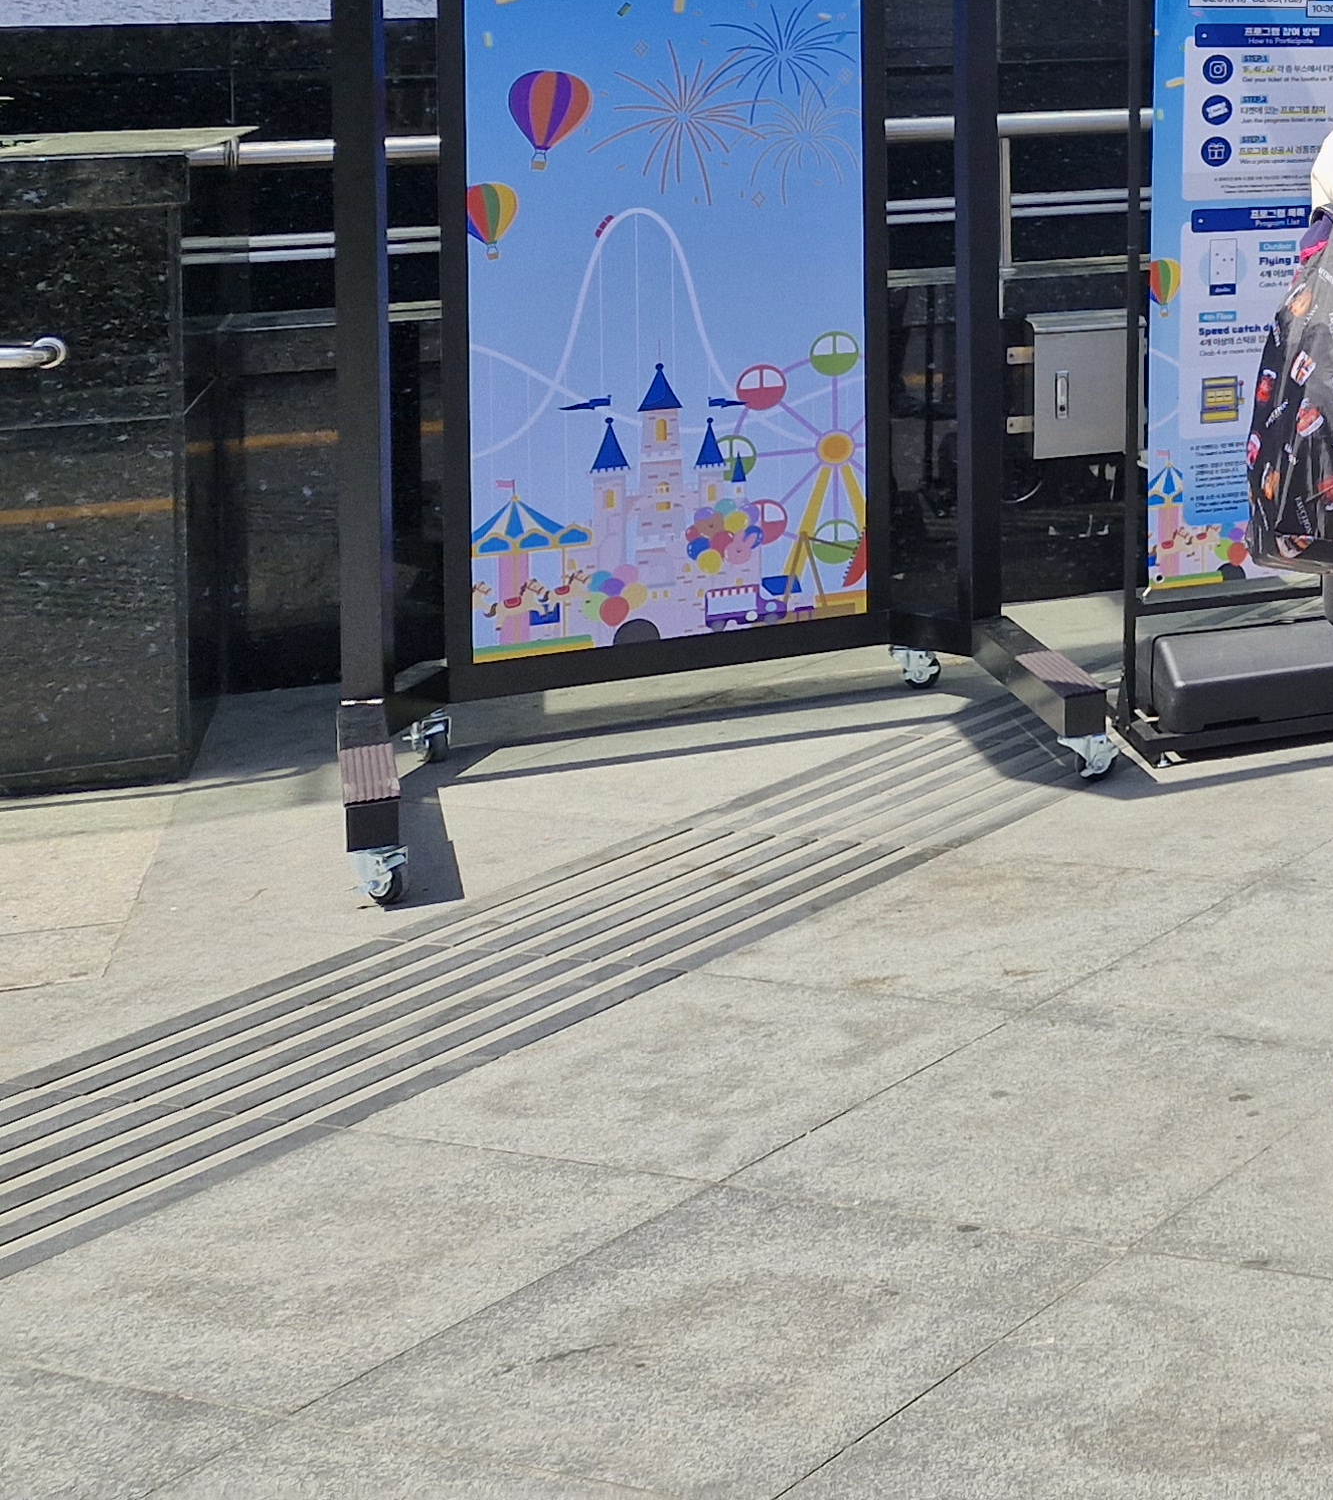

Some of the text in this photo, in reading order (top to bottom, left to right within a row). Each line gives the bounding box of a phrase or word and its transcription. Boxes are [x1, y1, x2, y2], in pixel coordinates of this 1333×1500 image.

[1255, 220, 1286, 228] Program
[1259, 256, 1291, 266] Flying
[1199, 326, 1230, 337] Speed
[1232, 324, 1261, 334] catch
